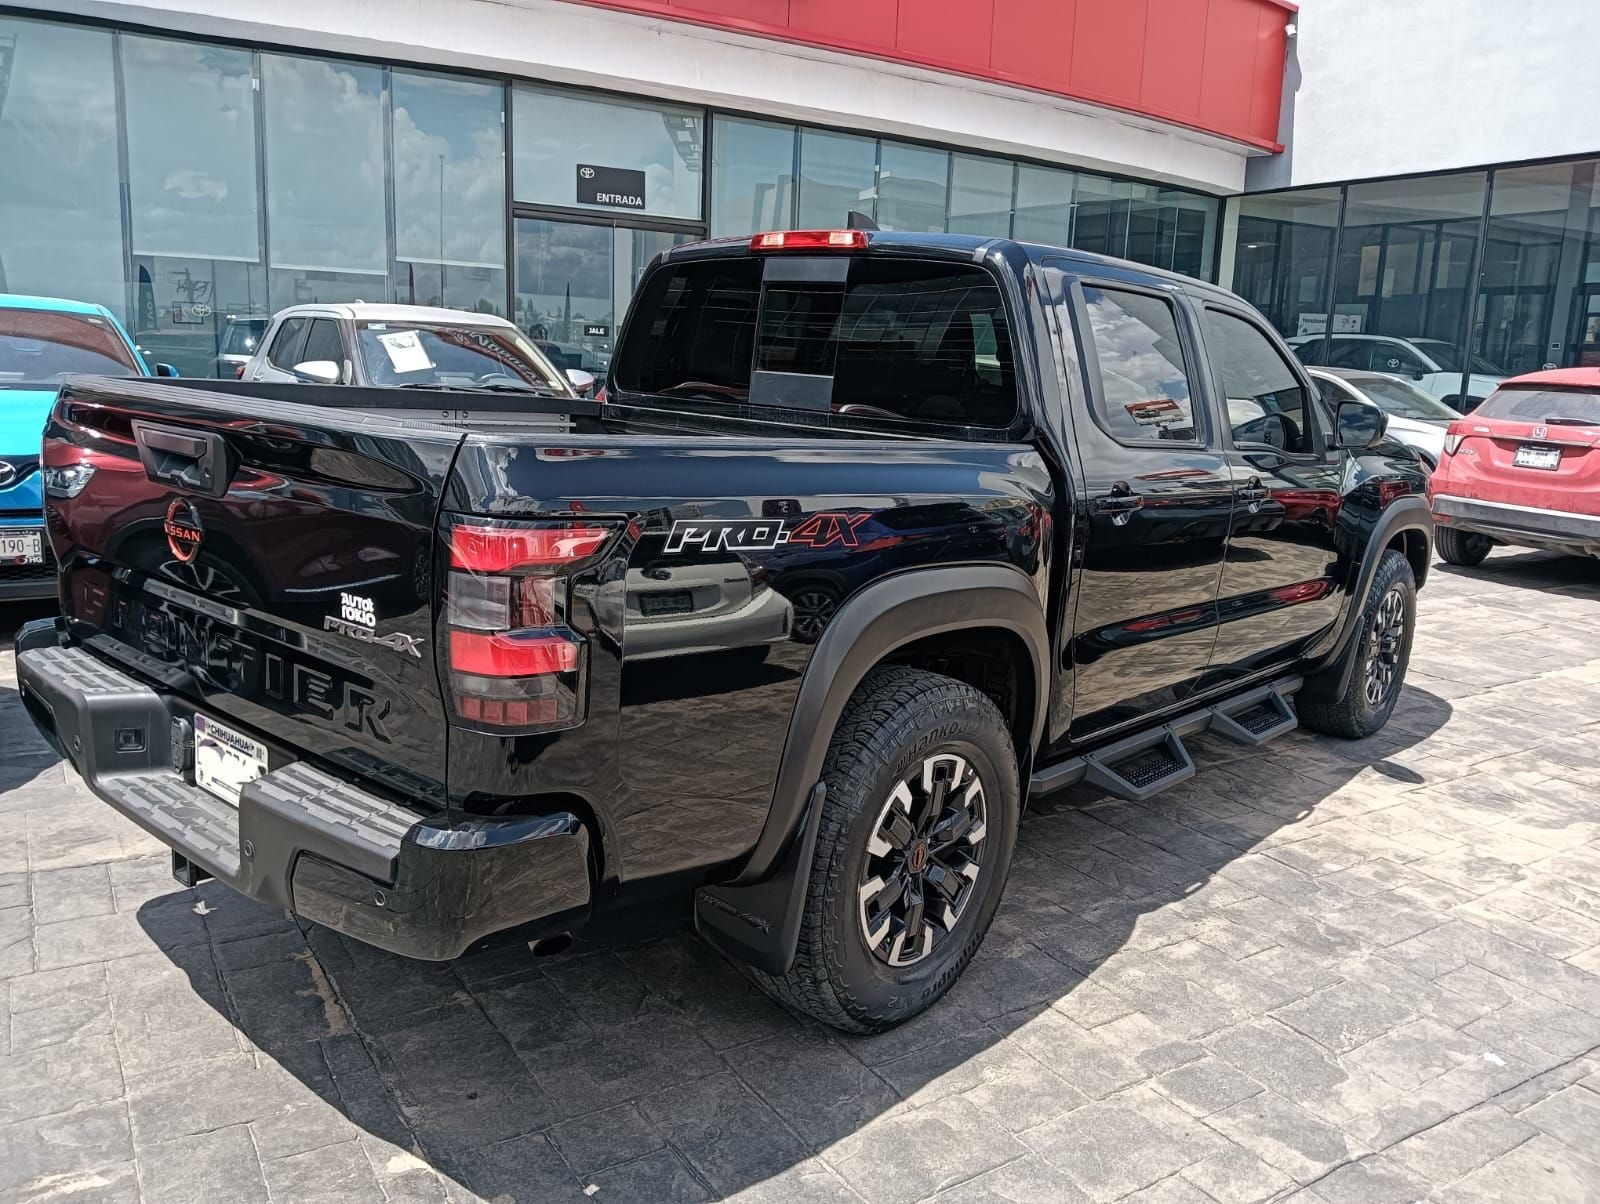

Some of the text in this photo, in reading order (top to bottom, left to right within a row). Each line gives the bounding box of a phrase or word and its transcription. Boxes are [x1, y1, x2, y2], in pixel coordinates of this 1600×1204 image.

[596, 192, 643, 206] ENTRADA
[167, 521, 201, 542] SSAN
[210, 724, 249, 750] CHIHUAHUA
